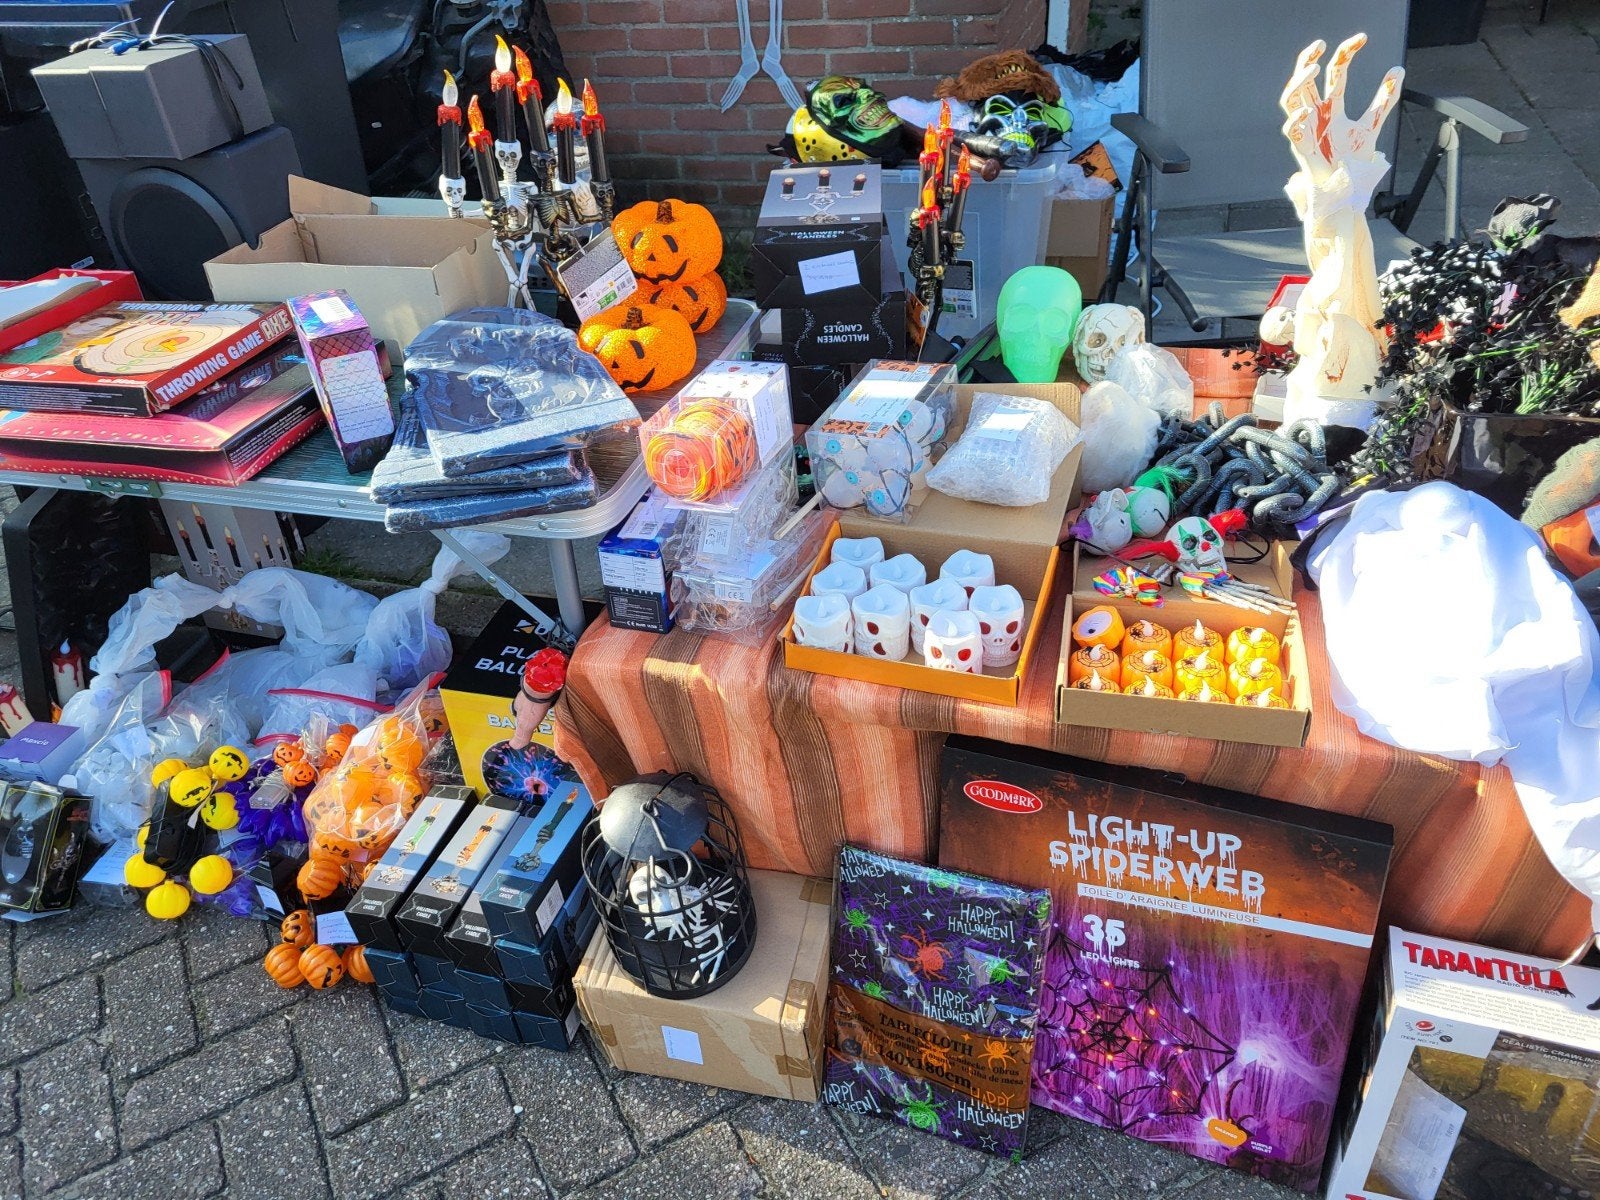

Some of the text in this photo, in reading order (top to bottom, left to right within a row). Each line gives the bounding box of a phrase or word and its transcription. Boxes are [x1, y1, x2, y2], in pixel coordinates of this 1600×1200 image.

[118, 302, 255, 312] THROWING GAME
[817, 334, 869, 344] HALLOWEEN
[823, 323, 863, 332] CANDLES
[155, 352, 230, 402] THROWING
[227, 330, 265, 361] GAME
[258, 308, 294, 342] AXE
[1067, 810, 1243, 864] LIGHT-UP
[1049, 840, 1266, 904] SPIDERWEB
[960, 903, 1000, 924] HAPPY
[1083, 886, 1112, 899] TOILE
[1192, 906, 1261, 926] LUMINEUSE
[948, 917, 1016, 944] HALLOWEEN!
[1083, 914, 1126, 948] 35
[1080, 950, 1140, 969] LED LIGHTS
[1402, 941, 1568, 992] TARANTULA
[932, 987, 969, 1009] HAPPY
[1496, 979, 1561, 997] RADIO CONTROL
[922, 1001, 988, 1029] HALLOWEEN!
[879, 1012, 974, 1057] TABLECLOTH
[1502, 1037, 1550, 1054] REALISTIC
[1542, 1053, 1595, 1069] MOVEMENT
[970, 1086, 1015, 1112] HAPPY
